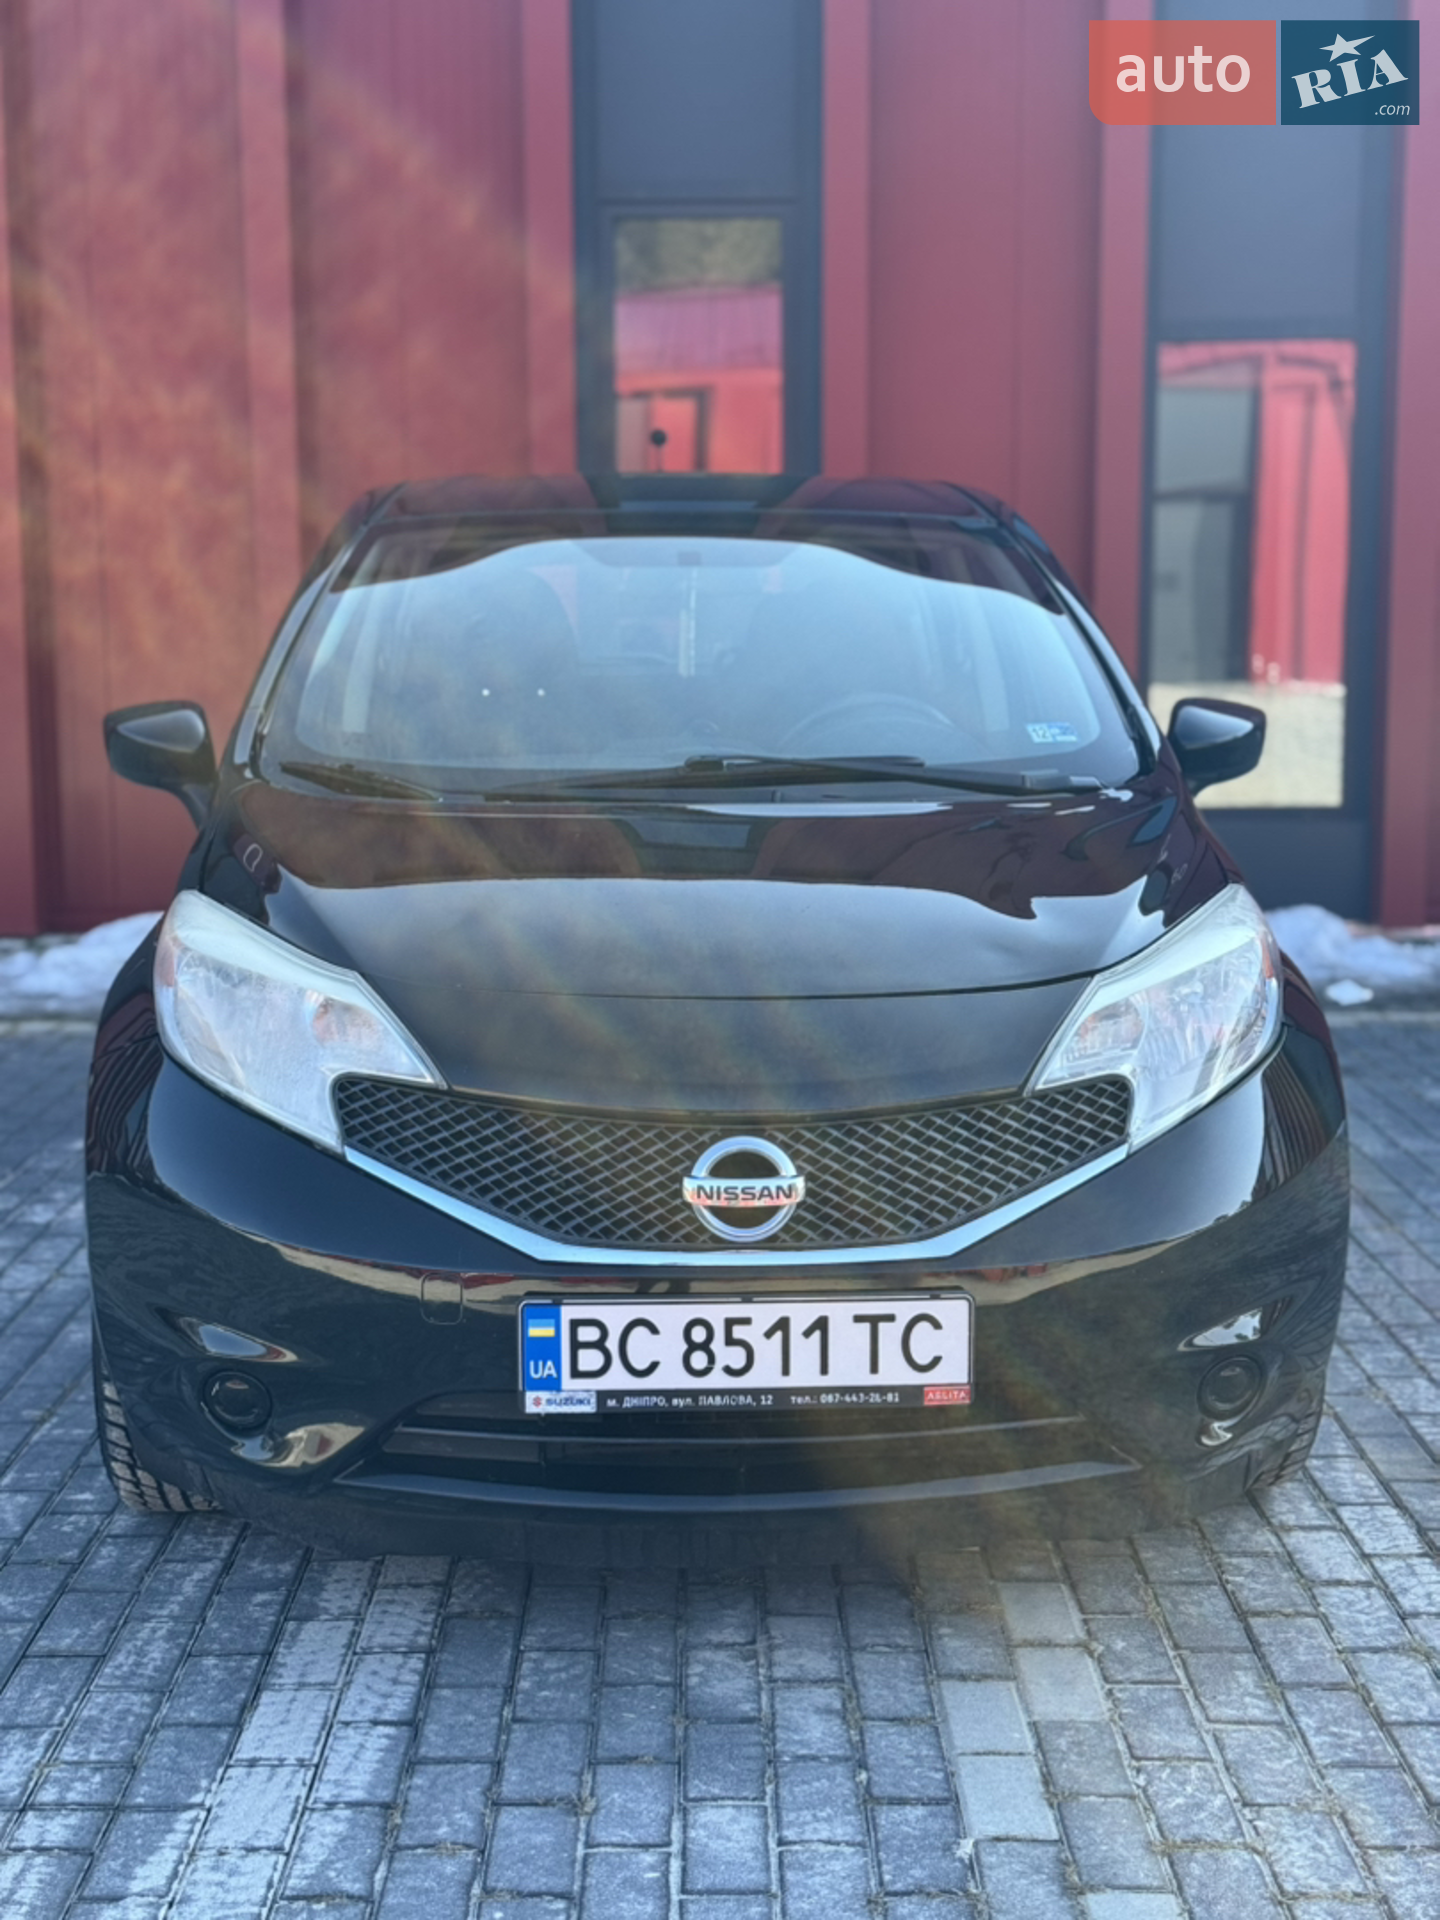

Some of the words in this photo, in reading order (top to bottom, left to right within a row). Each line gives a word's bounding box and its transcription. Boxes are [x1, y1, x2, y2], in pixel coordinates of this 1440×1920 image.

[696, 1183, 793, 1202] NISSAN
[568, 1317, 661, 1379] BC
[682, 1314, 830, 1378] 8511
[852, 1312, 944, 1375] TC
[529, 1360, 558, 1379] UA
[545, 1397, 592, 1407] SUZUKI
[760, 1394, 774, 1406] 12
